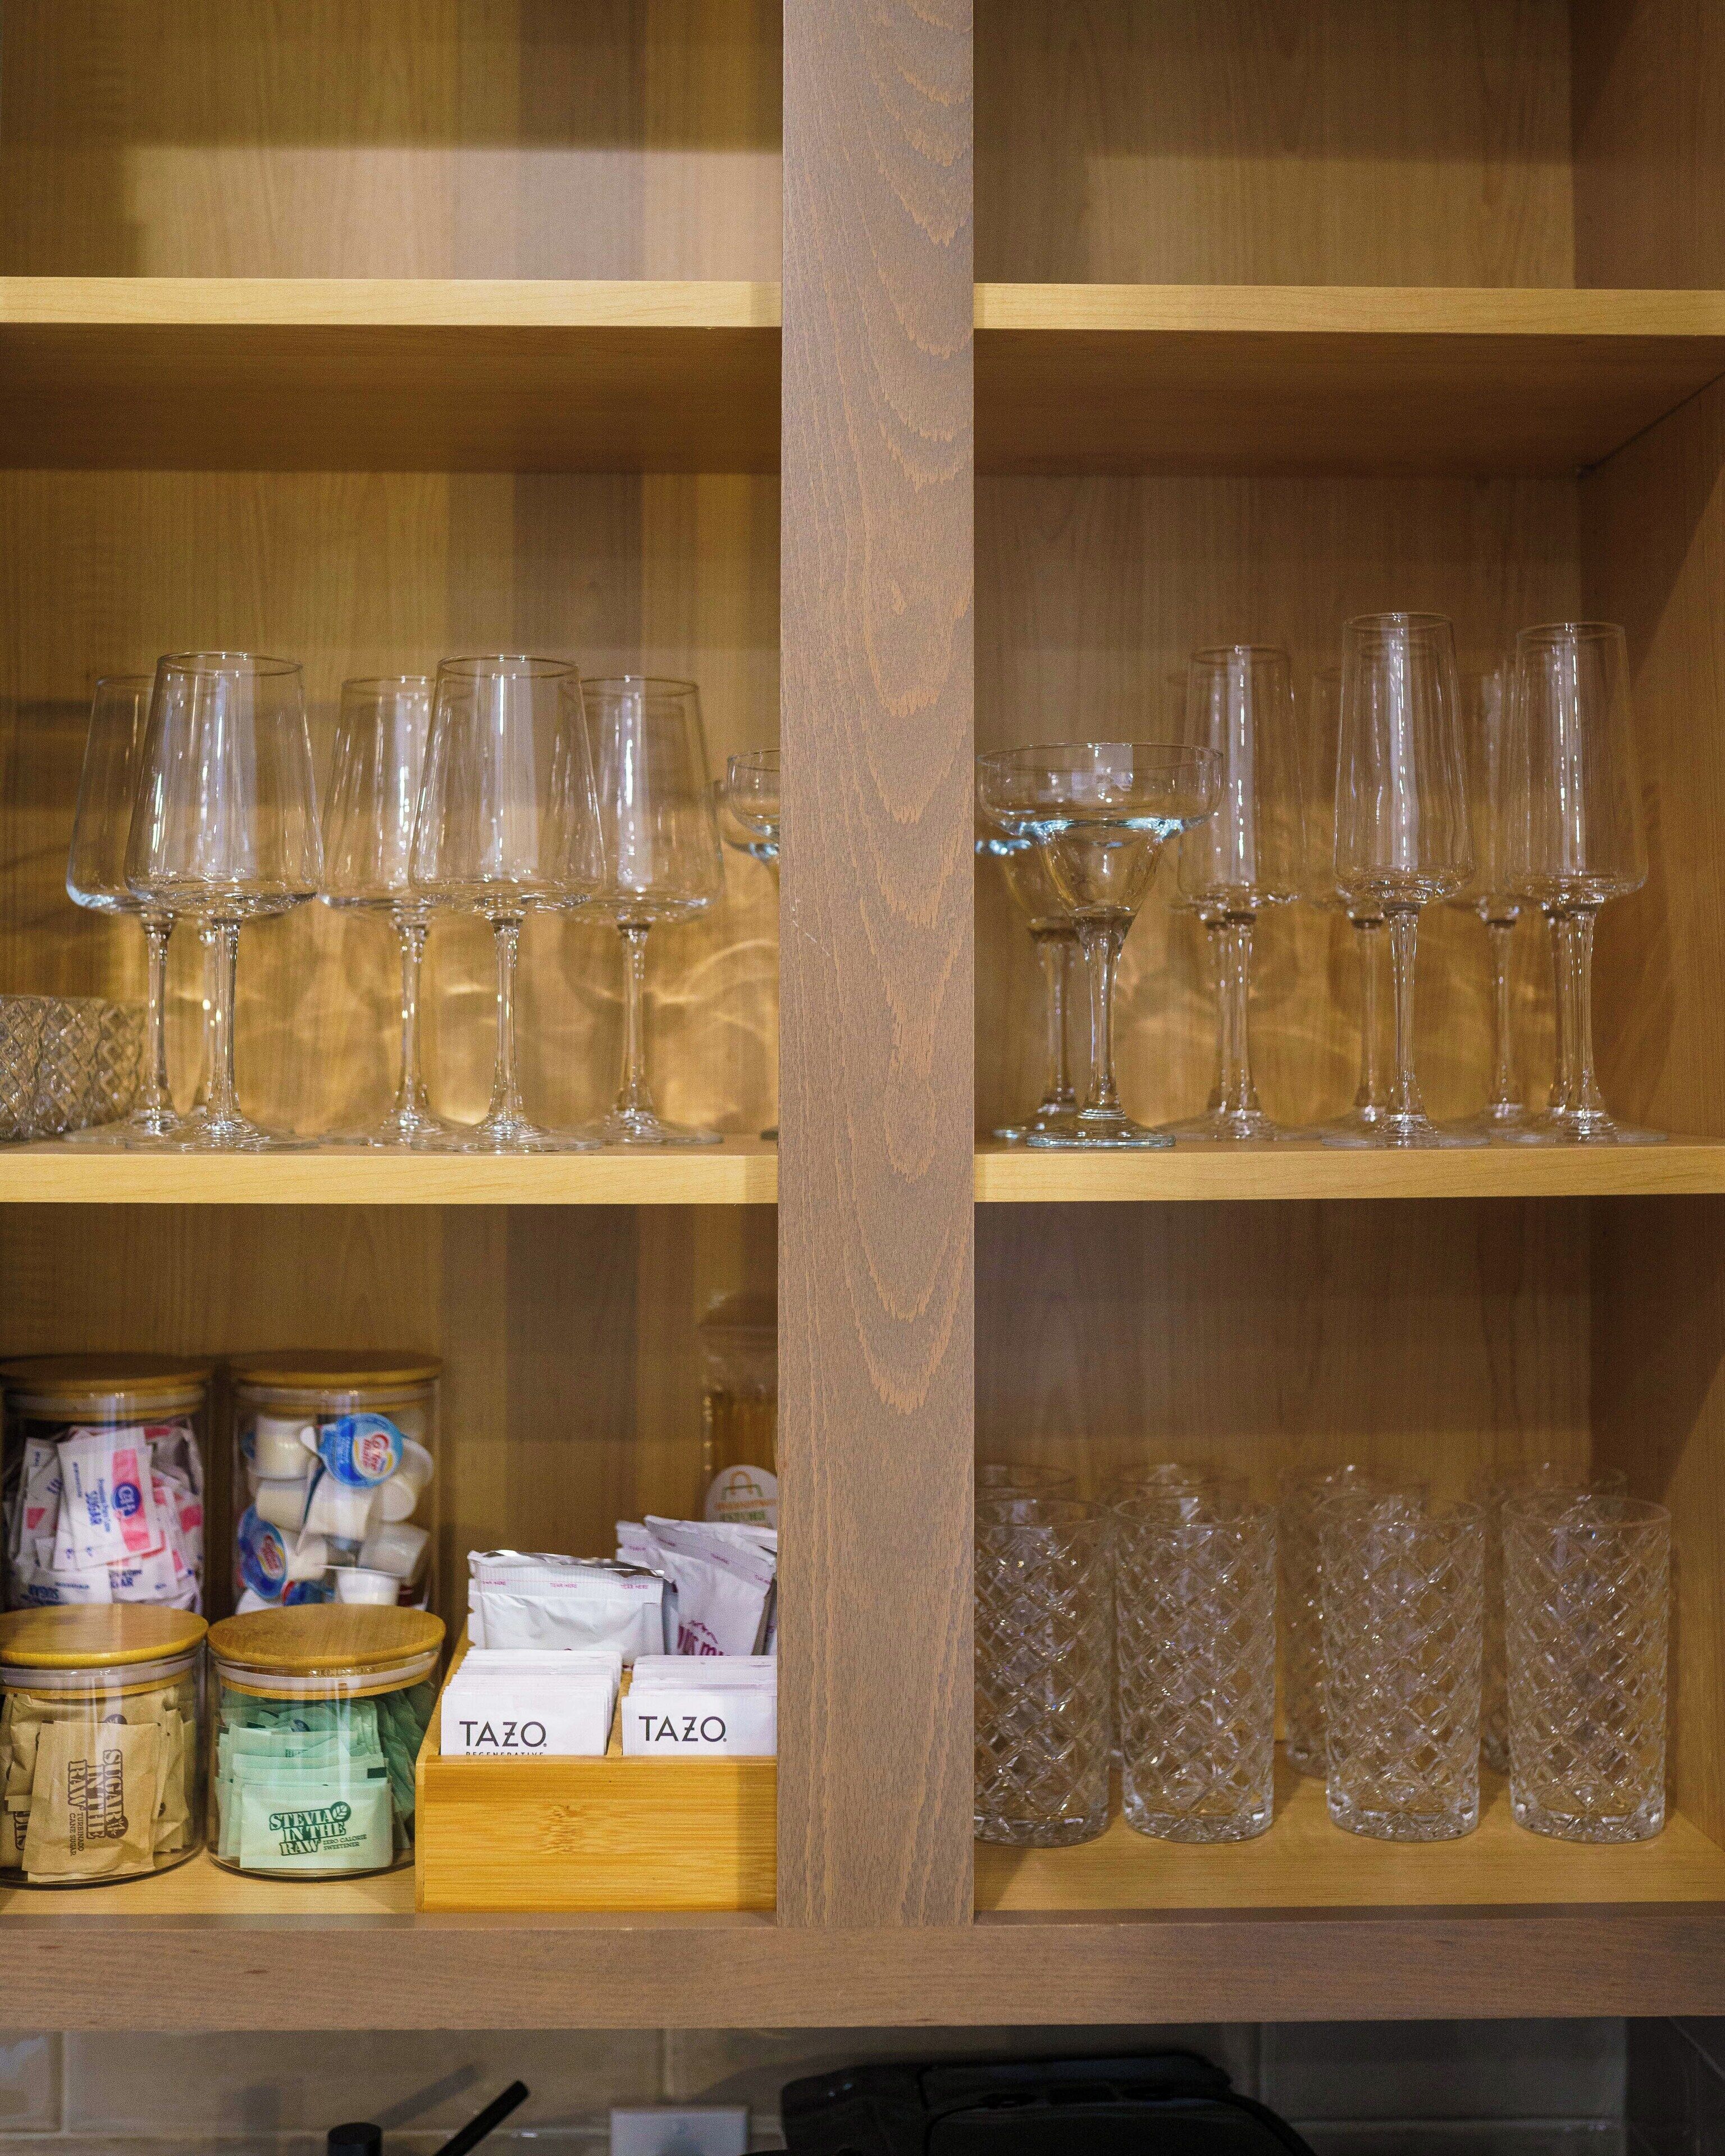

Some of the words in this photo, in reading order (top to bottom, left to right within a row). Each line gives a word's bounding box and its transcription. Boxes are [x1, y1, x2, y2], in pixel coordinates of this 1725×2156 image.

[459, 1721, 547, 1747] TAZO
[638, 1716, 726, 1742] TAZO
[68, 1760, 87, 1806] RAW
[86, 1764, 105, 1789] IN
[103, 1749, 124, 1825] SUGAR
[86, 1795, 106, 1839] THE
[270, 1808, 335, 1831] STEVIA
[283, 1826, 304, 1842] IN
[306, 1821, 345, 1840] THE
[280, 1839, 321, 1856] RAW
[323, 1842, 360, 1850] SWEETENER
